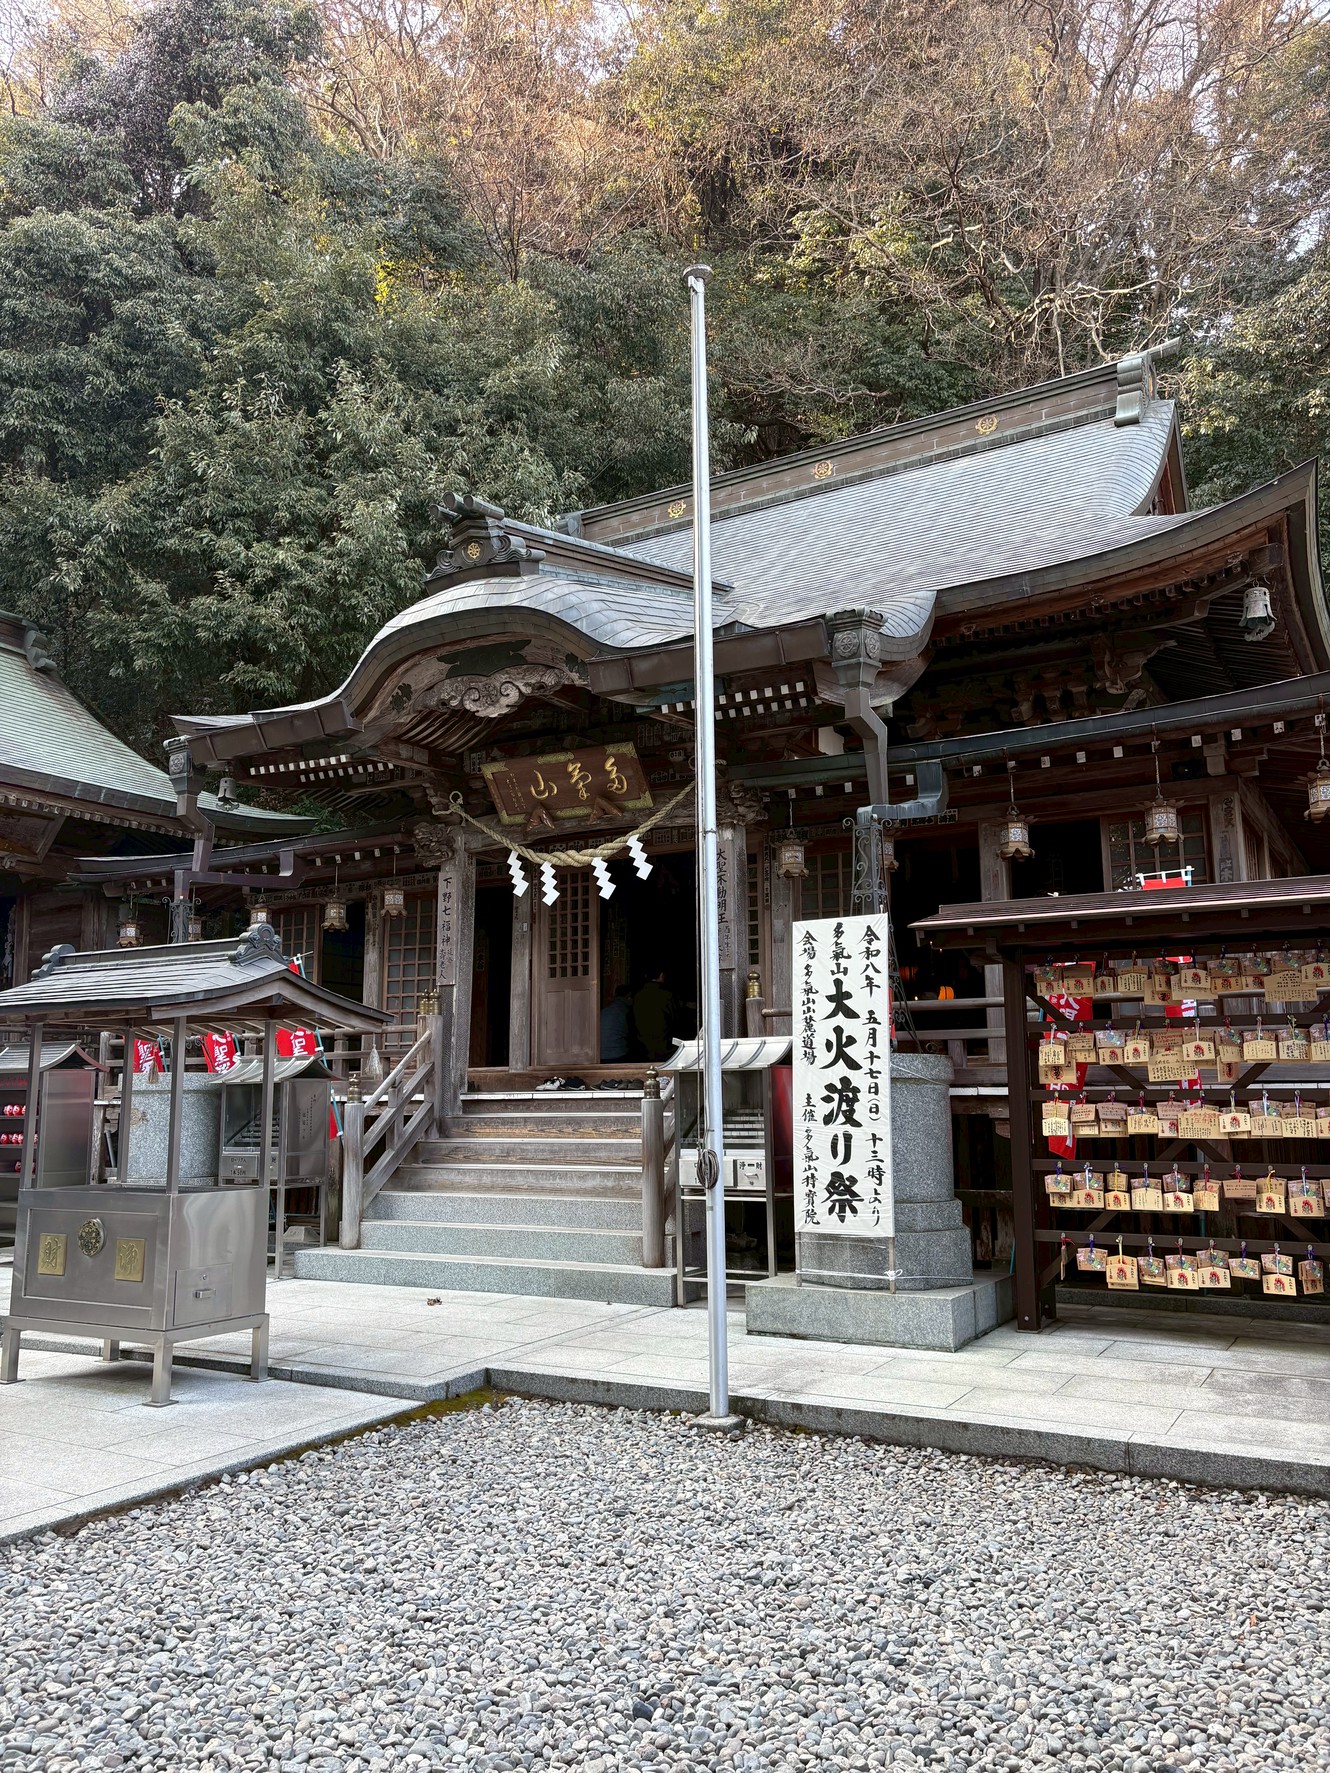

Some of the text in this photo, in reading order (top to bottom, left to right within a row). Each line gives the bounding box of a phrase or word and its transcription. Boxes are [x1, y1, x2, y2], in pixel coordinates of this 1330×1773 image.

[441, 876, 453, 947] 下野七福神
[797, 930, 818, 960] 会場
[858, 924, 882, 998] 令和八年
[802, 1093, 818, 1123] 主催
[819, 977, 864, 1225] 大火渡り祭
[863, 1132, 887, 1227] 十三時より
